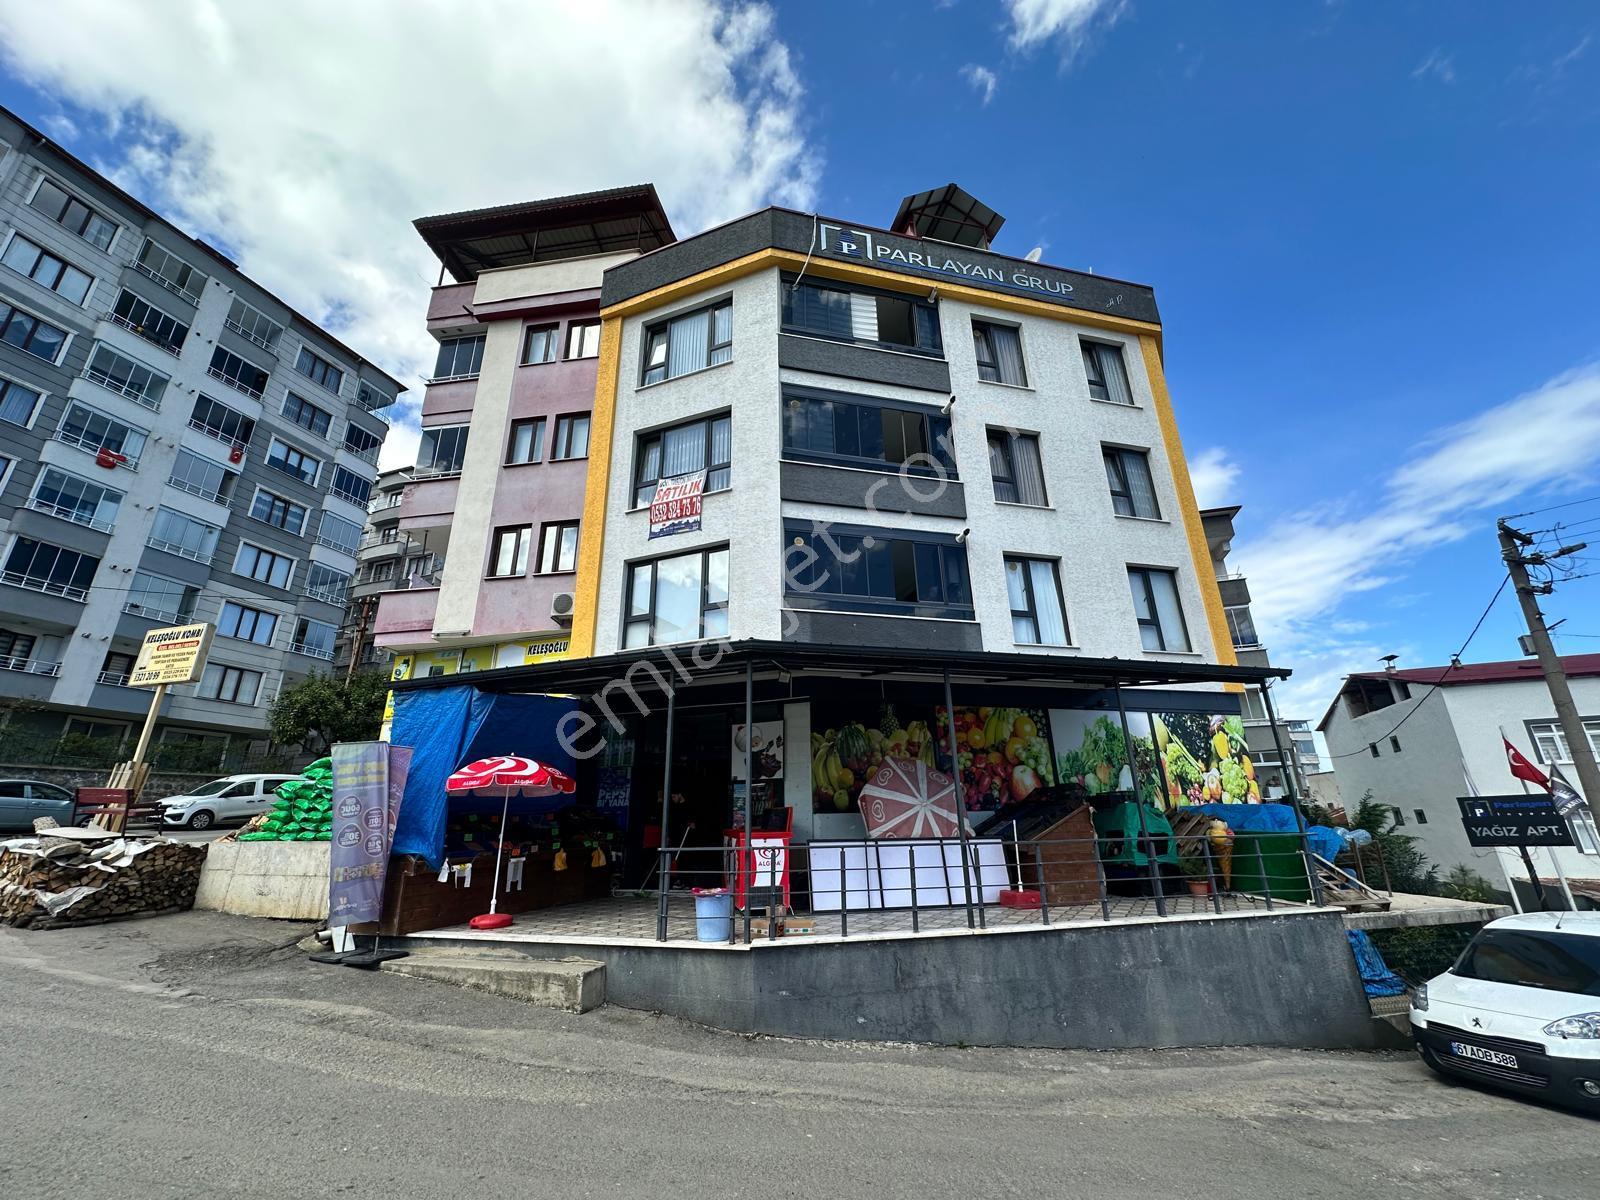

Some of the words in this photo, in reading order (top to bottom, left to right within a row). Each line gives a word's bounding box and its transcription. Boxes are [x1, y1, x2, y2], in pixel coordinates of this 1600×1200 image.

[876, 244, 1004, 282] PARLAYAN
[1012, 272, 1074, 296] GRUP
[656, 479, 702, 501] SATILIK
[146, 630, 181, 644] KELEŞOĞLU
[527, 641, 569, 656] KELEŞOĞLU
[1472, 824, 1519, 837] YAĞIZ
[1526, 825, 1562, 837] APT.
[1456, 1043, 1469, 1053] 61
[1470, 1046, 1493, 1061] ADB
[1495, 1052, 1516, 1066] 588
